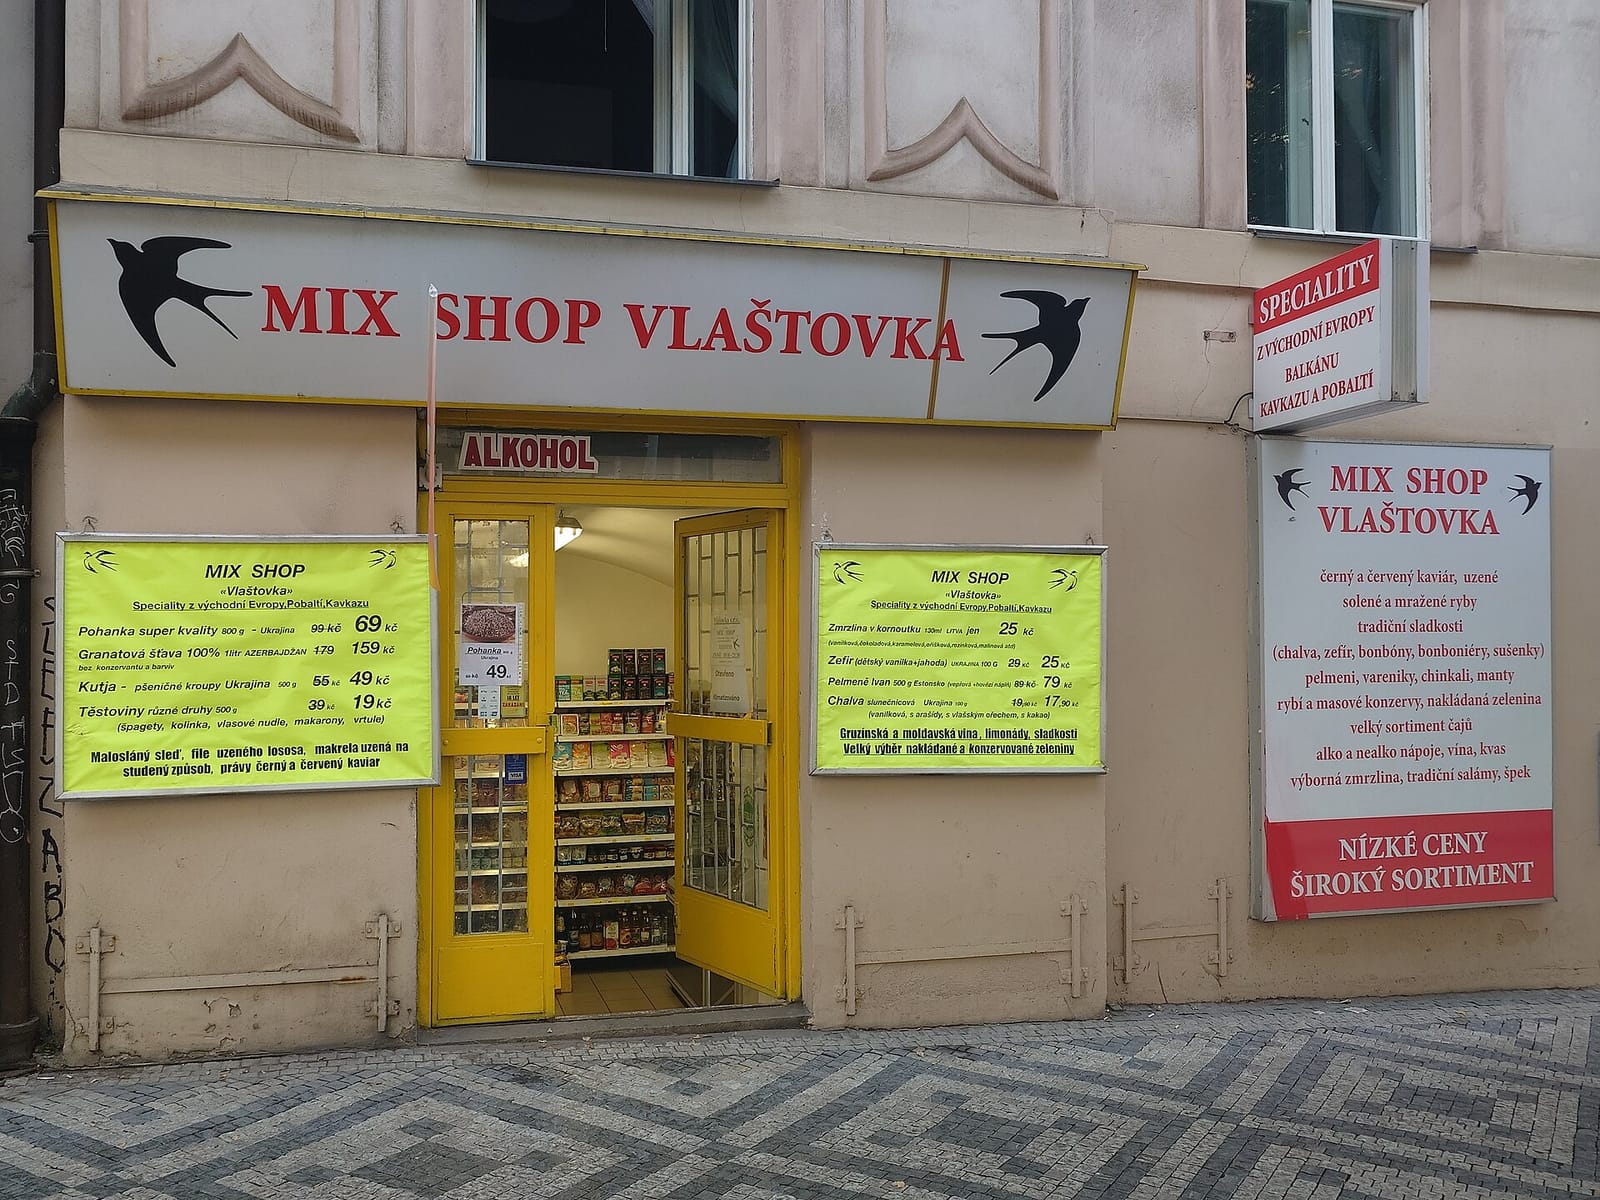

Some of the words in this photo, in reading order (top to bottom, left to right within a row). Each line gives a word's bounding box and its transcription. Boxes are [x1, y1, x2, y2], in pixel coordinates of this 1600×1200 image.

[1259, 254, 1374, 324] SPECIALITY
[261, 285, 400, 337] MIX
[435, 292, 601, 345] SHOP
[624, 297, 965, 362] VLAŠTOVKA
[1264, 320, 1323, 357] VÝCHODNÍ
[1325, 306, 1375, 337] EVROPY
[1285, 352, 1340, 383] BALKÁNU
[1260, 389, 1310, 418] KAVKAZU
[1322, 369, 1374, 400] POBALTÍ
[463, 435, 595, 471] ALKOHOL
[1330, 465, 1393, 493] MIX
[1406, 467, 1488, 495] SHOP
[1318, 501, 1500, 535] VLAŠTOVKA
[204, 564, 242, 579] MIX
[251, 564, 306, 579] SHOP
[931, 570, 960, 583] MIX
[967, 571, 1009, 585] SHOP
[1320, 569, 1354, 587] černý
[1367, 569, 1414, 587] červený
[1417, 569, 1458, 586] kaviár,
[1463, 570, 1499, 584] uzené
[220, 586, 293, 597] «Vlaštovka»
[945, 589, 1001, 600] «Vlaštovka»
[132, 601, 186, 611] Speciality
[197, 600, 246, 611] východní
[870, 600, 911, 610] Speciality
[920, 601, 958, 611] východní
[1343, 594, 1382, 609] solené
[1395, 594, 1447, 608] mražené
[1450, 595, 1477, 612] ryby
[79, 626, 135, 637] Pohanka
[139, 628, 175, 638] super
[178, 625, 218, 637] kvality
[260, 626, 295, 635] Ukrajina
[311, 624, 324, 633] 99
[355, 614, 382, 633] 69
[385, 623, 398, 633] kč
[828, 623, 867, 633] Zmrzlina
[876, 624, 921, 634] kornoutku
[966, 626, 980, 636] jen
[999, 622, 1018, 635] 25
[1357, 619, 1407, 633] tradiční
[1409, 619, 1463, 633] sladkosti
[79, 649, 145, 660] Granatová
[187, 648, 220, 658] 100%
[225, 649, 242, 657] 1litr
[244, 647, 307, 657] AZERBAJDŽAN
[313, 645, 335, 655] 179
[351, 641, 380, 655] 159
[466, 646, 502, 655] Pohanka
[1273, 645, 1321, 662] (chalva,
[1358, 644, 1415, 662] bonbóny,
[1418, 643, 1490, 661] bonboniéry,
[1493, 643, 1545, 660] sušenky)
[96, 663, 143, 672] konzervantu
[152, 663, 175, 671] barviv
[855, 657, 883, 667] (dětský
[1041, 655, 1060, 668] 25
[486, 664, 507, 679] 49
[1304, 670, 1360, 688] pelmeni,
[1363, 669, 1418, 686] vareniky,
[1421, 668, 1474, 684] chinkali,
[1477, 669, 1515, 684] manty
[78, 681, 116, 694] Kutja
[134, 682, 182, 693] pšeničné
[185, 681, 221, 692] kroupy
[224, 680, 270, 690] Ukrajina
[312, 675, 330, 687] 55
[350, 671, 373, 686] 49
[871, 677, 890, 687] Ivan
[1043, 676, 1061, 688] 79
[79, 705, 145, 718] Těstoviny
[147, 705, 178, 716] různé
[181, 705, 213, 716] druhy
[308, 699, 325, 711] 39
[353, 694, 375, 709] 19
[376, 698, 392, 709] kč
[827, 695, 864, 706] Chalva
[923, 699, 953, 708] Ukrajina
[1044, 695, 1070, 707] 17,90
[1277, 696, 1303, 714] rybí
[1316, 695, 1362, 710] masové
[1365, 694, 1424, 712] konzervy,
[1427, 692, 1489, 708] nakládaná
[1492, 692, 1542, 706] zelenina
[117, 721, 165, 733] (špagety,
[171, 720, 211, 731] kolinka,
[217, 719, 255, 729] vlasové
[258, 717, 288, 728] nudle,
[294, 717, 345, 727] makarony,
[353, 715, 385, 726] vrtule)
[1026, 711, 1050, 720] kakao)
[902, 727, 956, 739] moldavská
[985, 727, 1031, 740] limonády,
[1034, 728, 1078, 739] sladkosti
[1350, 718, 1382, 737] velký
[1385, 720, 1445, 734] sortiment
[1448, 717, 1473, 735] čajů
[191, 747, 210, 760] file
[217, 746, 263, 759] uzeného
[267, 745, 306, 757] lososa,
[315, 742, 358, 755] makrela
[361, 741, 392, 753] uzená
[396, 742, 409, 752] na
[843, 743, 871, 755] Velký
[875, 743, 902, 755] výběr
[906, 743, 958, 754] nakládané
[969, 743, 1034, 754] konzervované
[1035, 743, 1075, 755] zeleniny
[1316, 746, 1342, 761] alko
[1356, 745, 1397, 759] nealko
[1400, 744, 1445, 761] nápoje,
[1447, 743, 1477, 758] vína,
[1479, 741, 1506, 755] kvas
[123, 763, 169, 777] studený
[172, 762, 214, 776] způsob,
[220, 760, 251, 774] právy
[256, 759, 287, 772] černý
[300, 757, 343, 770] červený
[347, 756, 381, 769] kaviar
[1290, 771, 1342, 791] výborná
[1345, 769, 1403, 787] zmrzlina,
[1406, 767, 1455, 783] tradiční
[1458, 766, 1501, 783] salámy,
[1503, 764, 1531, 781] špek
[1338, 830, 1418, 862] NÍZKÉ
[1423, 831, 1488, 856] CENY
[1290, 865, 1387, 898] ŠIROKÝ
[1391, 861, 1534, 890] SORTIMENT
